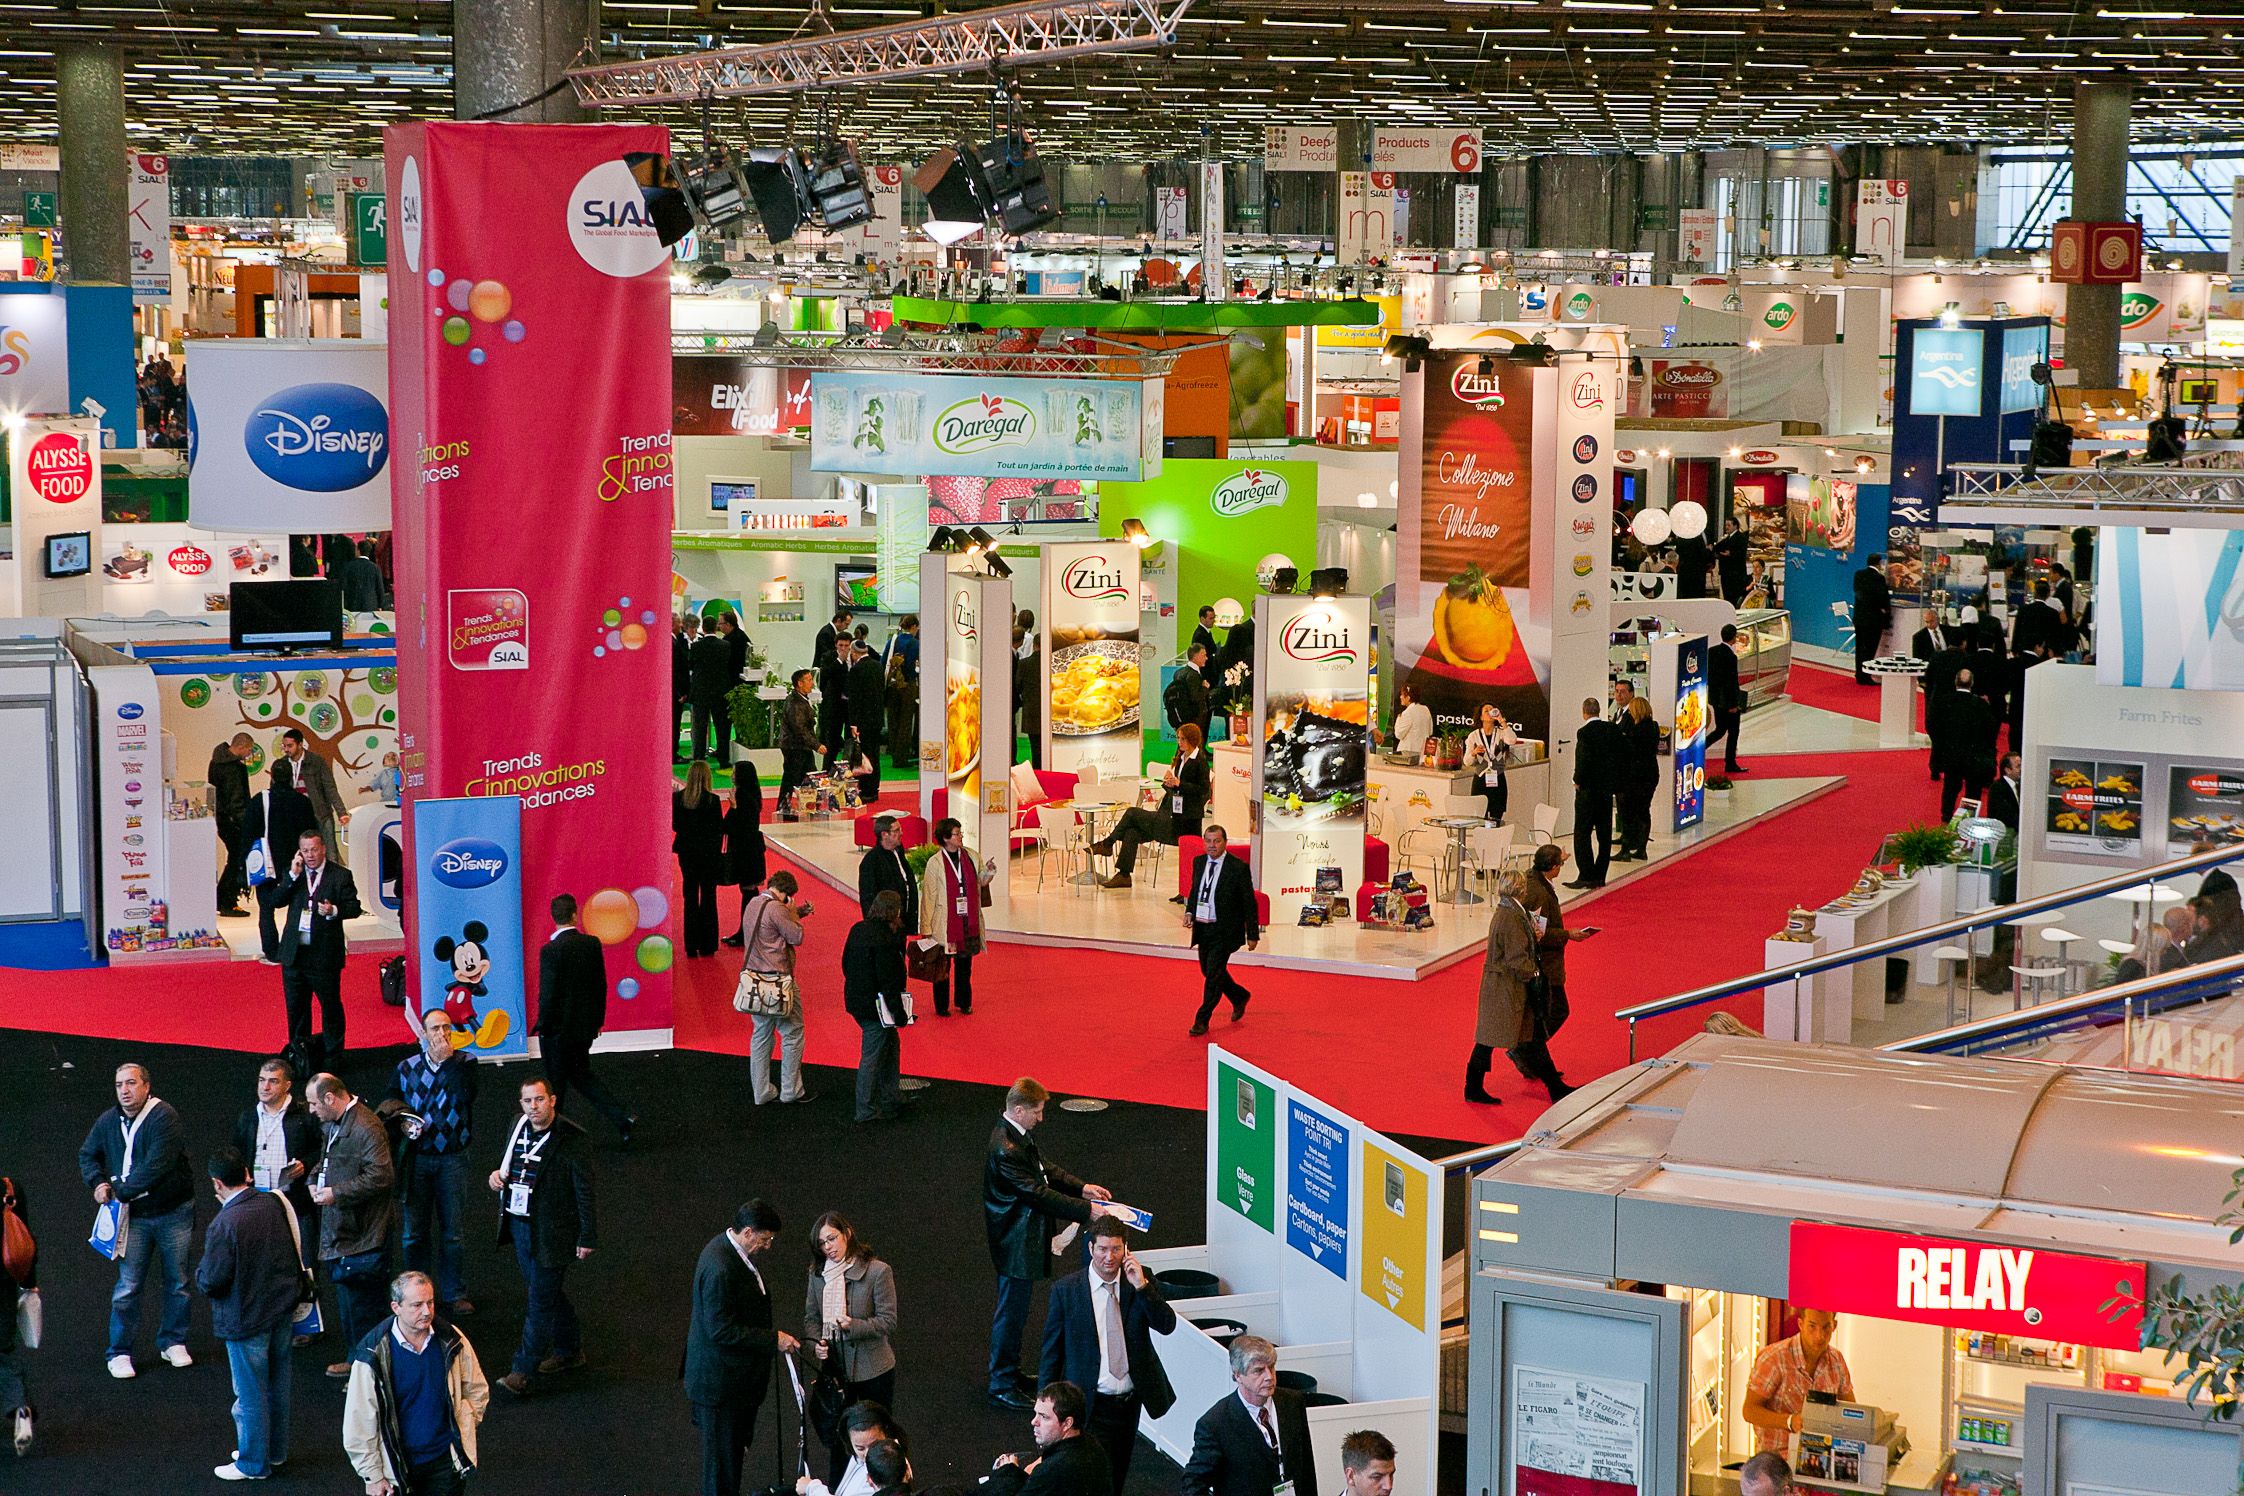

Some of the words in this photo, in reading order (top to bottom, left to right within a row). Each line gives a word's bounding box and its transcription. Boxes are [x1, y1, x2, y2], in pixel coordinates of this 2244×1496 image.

[1378, 137, 1430, 148] Products
[1374, 151, 1395, 162] elés
[1451, 134, 1478, 172] 6
[153, 157, 165, 170] 6
[138, 175, 161, 184] SIAL
[887, 168, 899, 182] 6
[1382, 173, 1393, 187] 6
[874, 185, 896, 194] SIAL
[1370, 190, 1389, 198] SIAL
[1896, 181, 1907, 195] 6
[629, 229, 658, 238] Marketpla
[1349, 210, 1385, 240] m
[1570, 298, 1589, 311] ardo
[2121, 299, 2148, 317] do
[1767, 307, 1790, 322] ardo
[1919, 350, 1964, 362] Argentina
[1459, 373, 1500, 394] Zini
[1672, 371, 1714, 384] Donatella
[1577, 383, 1601, 401] Zini
[1653, 392, 1672, 400] ARTE
[711, 384, 751, 430] Elix
[736, 407, 779, 430] Food
[943, 413, 1029, 442] Daregal
[257, 409, 384, 469] Disney
[620, 429, 672, 454] Trend
[33, 447, 87, 469] ALYSSE
[997, 460, 1016, 470] Tout
[1029, 461, 1056, 473] jardin
[1094, 463, 1105, 472] de
[1107, 464, 1129, 473] main
[1438, 451, 1515, 499] Collezione
[40, 475, 85, 499] FOOD
[1219, 479, 1281, 508] Daregal
[1892, 496, 1922, 507] Argentina
[1438, 503, 1500, 541] Milano
[697, 538, 743, 549] Aromatiques
[751, 541, 784, 549] Aromatic
[785, 541, 807, 549] Herbs
[814, 542, 840, 551] Herbes
[841, 543, 877, 552] Aromatiq
[170, 551, 208, 563] ALYSSE
[175, 562, 206, 574] FOOD
[1073, 569, 1123, 590] Zini
[464, 613, 493, 626] Trends
[957, 603, 975, 629] Zini
[465, 618, 525, 637] innovations
[470, 629, 519, 646] Tendances
[1292, 627, 1350, 649] Zini
[494, 651, 525, 663] SIAL
[2119, 708, 2157, 724] Farm
[2162, 710, 2203, 727] Frites
[117, 724, 147, 738] MARVEL
[482, 751, 542, 777] Trends
[484, 757, 607, 797] innovations
[519, 781, 595, 810] ndances
[2066, 793, 2094, 802] FARM
[2094, 794, 2125, 805] FRITES
[436, 851, 503, 877] Disney
[1294, 1108, 1316, 1129] WASTE
[1316, 1120, 1343, 1144] SORTING
[1305, 1126, 1322, 1144] POINT
[1322, 1136, 1332, 1150] TRI
[1236, 1166, 1255, 1187] Glass
[1237, 1183, 1254, 1202] Verre
[1288, 1193, 1326, 1229] Cardboard,
[1326, 1219, 1347, 1240] paper
[1291, 1212, 1318, 1240] Cartons,
[1318, 1231, 1342, 1254] papiers
[1382, 1256, 1404, 1279] Other
[1381, 1273, 1404, 1298] Autres
[1897, 1247, 2035, 1312] RELAY
[1518, 1404, 1528, 1412] LE
[1530, 1405, 1558, 1415] FIGARO
[1585, 1407, 1593, 1416] SE
[1593, 1450, 1627, 1460] ampionnat
[1605, 1459, 1633, 1470] loufoque
